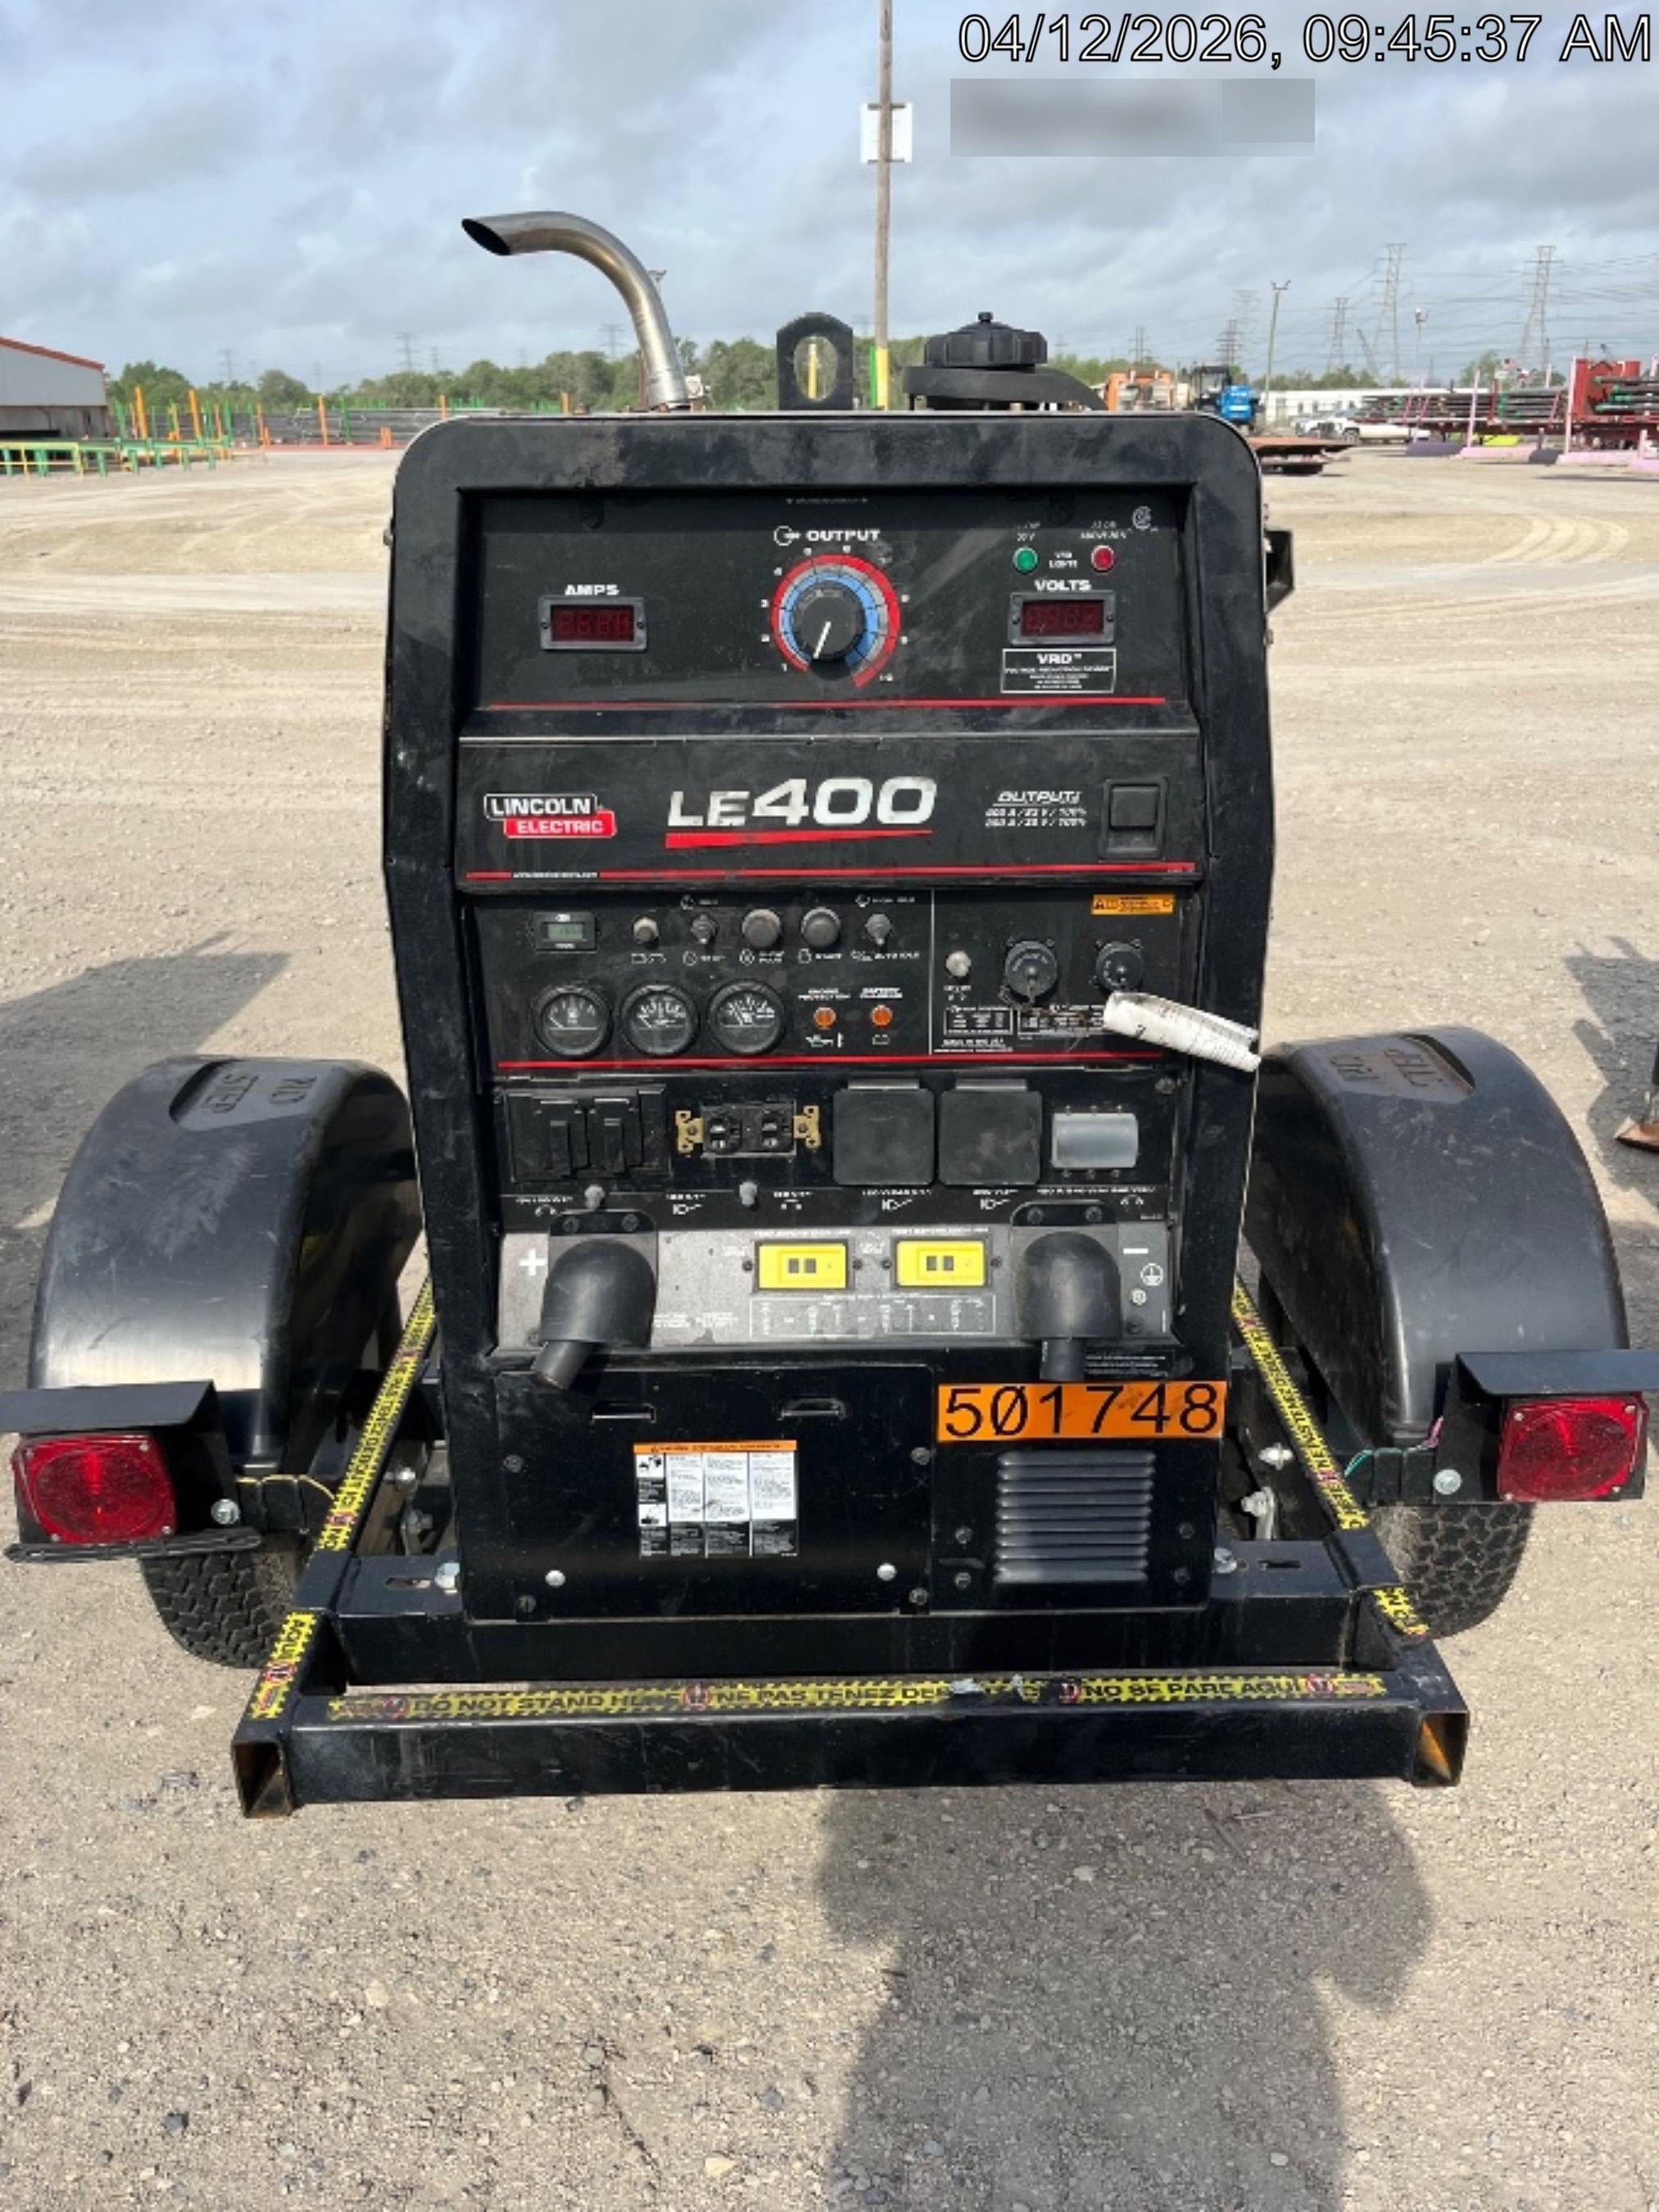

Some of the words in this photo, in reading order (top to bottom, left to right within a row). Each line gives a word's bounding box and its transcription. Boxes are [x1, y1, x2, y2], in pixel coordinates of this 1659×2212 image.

[806, 529, 881, 541] OUTPUT
[564, 584, 619, 596] AMPS
[1034, 579, 1092, 591] VOLTS
[492, 798, 591, 815] LINCOLN
[667, 776, 938, 827] LE400
[516, 820, 604, 834] ELECTRIC
[945, 1383, 1218, 1438] 501748
[759, 1690, 807, 1702] PAS
[818, 1688, 896, 1700] TENEZ
[1086, 1684, 1122, 1697] NO
[414, 1699, 450, 1711] DO
[458, 1698, 510, 1711] NOT
[518, 1696, 603, 1709] STAND
